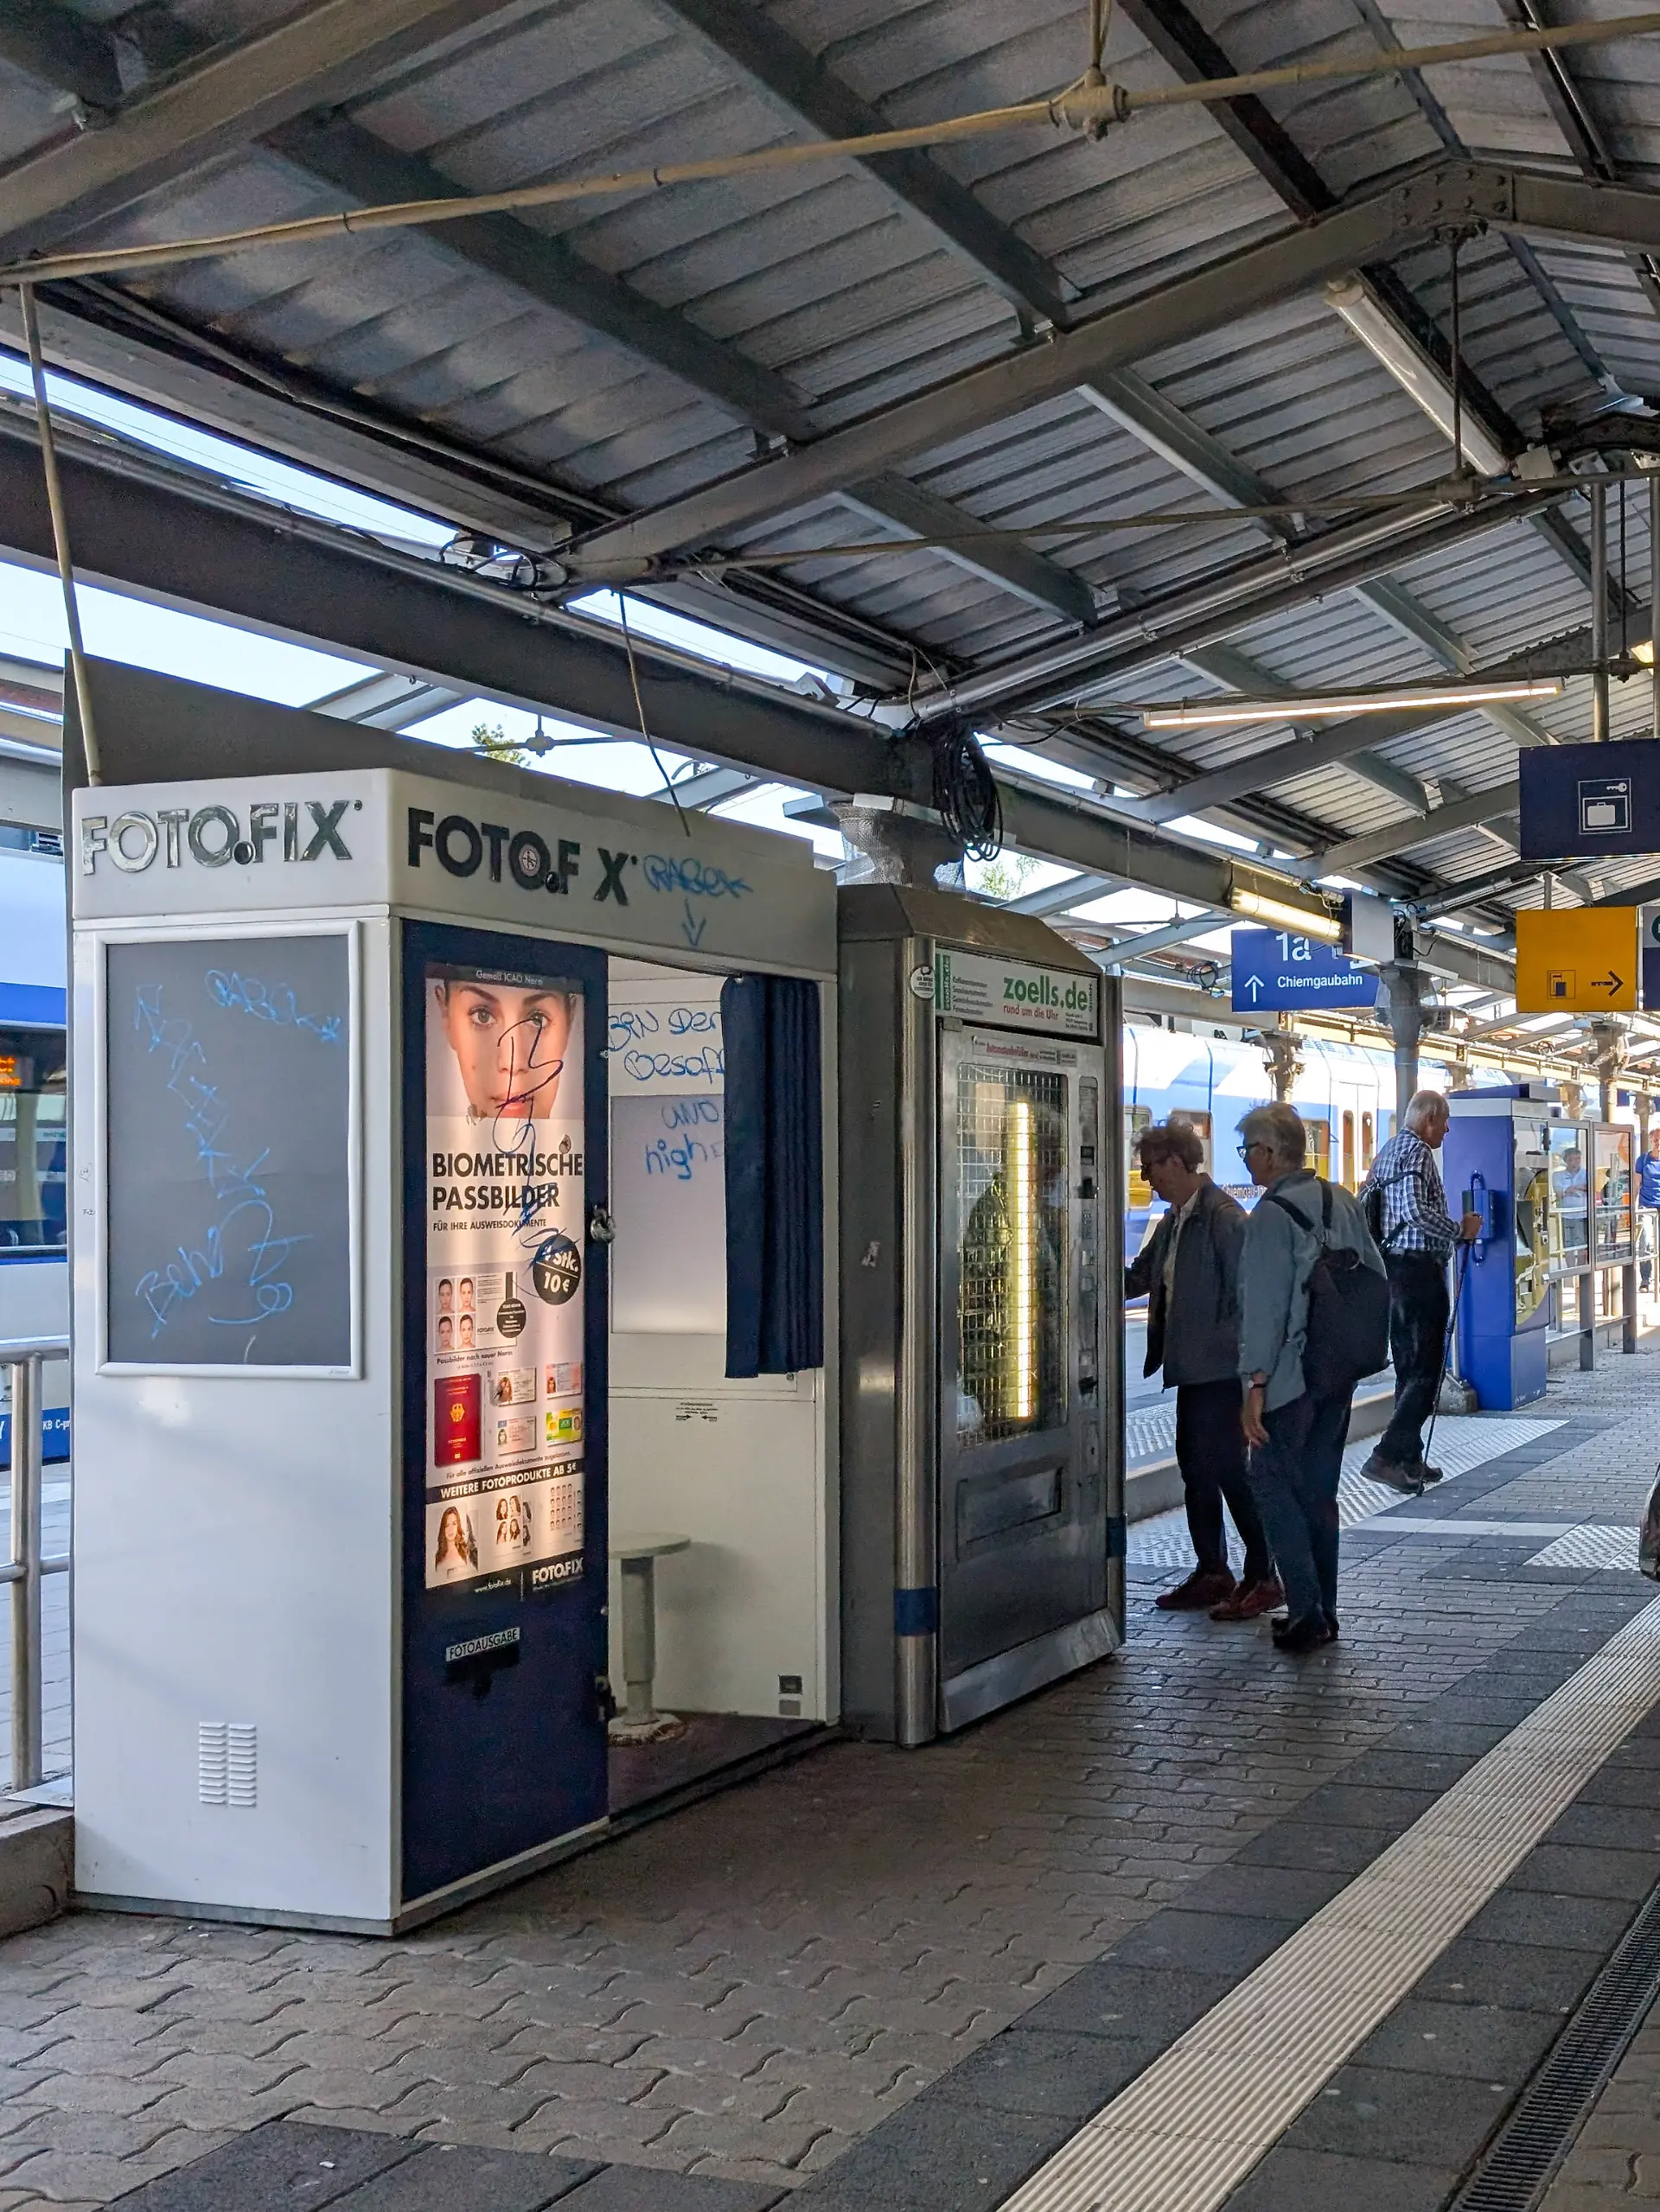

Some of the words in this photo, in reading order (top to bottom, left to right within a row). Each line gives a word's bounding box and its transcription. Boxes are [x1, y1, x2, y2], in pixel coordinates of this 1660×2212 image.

[1276, 932, 1312, 961] 1a
[1003, 975, 1088, 1011] zoells.de
[1277, 973, 1363, 989] Chiemgaubahn
[1003, 1004, 1020, 1015] rund
[1021, 1008, 1033, 1017] um
[1034, 1007, 1044, 1019] die
[1046, 1009, 1059, 1020] Uhr
[432, 1153, 583, 1177] BIOMETRISCHE
[432, 1184, 560, 1210] PASSBILDER
[433, 1220, 449, 1232] FÜR
[450, 1221, 468, 1231] IHRE
[552, 1249, 579, 1273] Stk.
[440, 1482, 479, 1499] WEITERE
[482, 1468, 551, 1491] FOTOPRODUKTE
[552, 1464, 565, 1476] AB
[449, 1629, 518, 1659] FOTOAUSGABE
